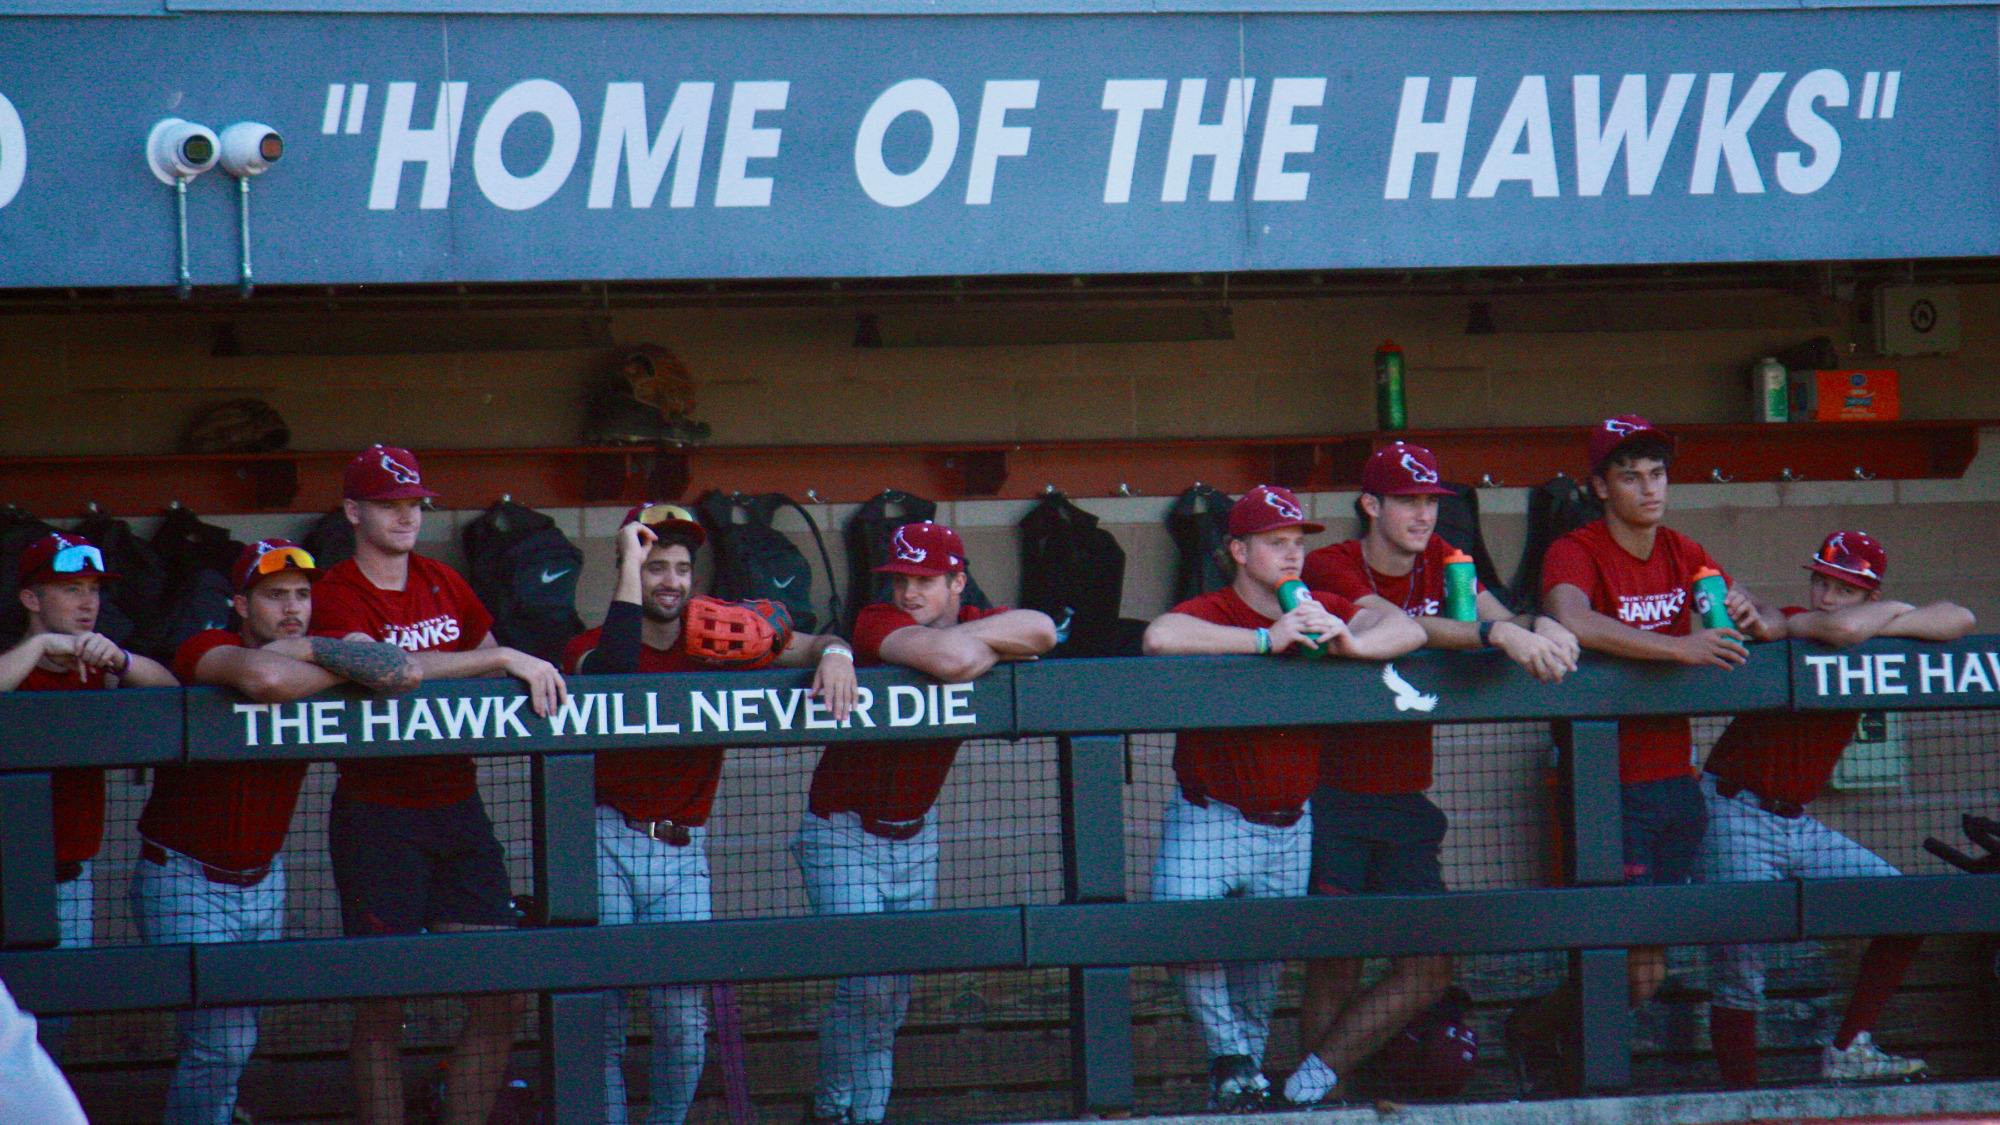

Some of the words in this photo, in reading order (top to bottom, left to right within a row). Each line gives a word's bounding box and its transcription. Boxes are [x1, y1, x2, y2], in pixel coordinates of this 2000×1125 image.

[322, 78, 791, 210] "HOME
[855, 78, 1040, 207] OF
[1101, 77, 1327, 204] THE
[1384, 68, 1901, 200] HAWKS"
[1804, 653, 1909, 696] THE
[233, 700, 348, 746] THE
[361, 695, 532, 742] HAWK
[546, 692, 681, 736] WILL
[689, 686, 877, 733] NEVER
[887, 682, 977, 728] DIE
